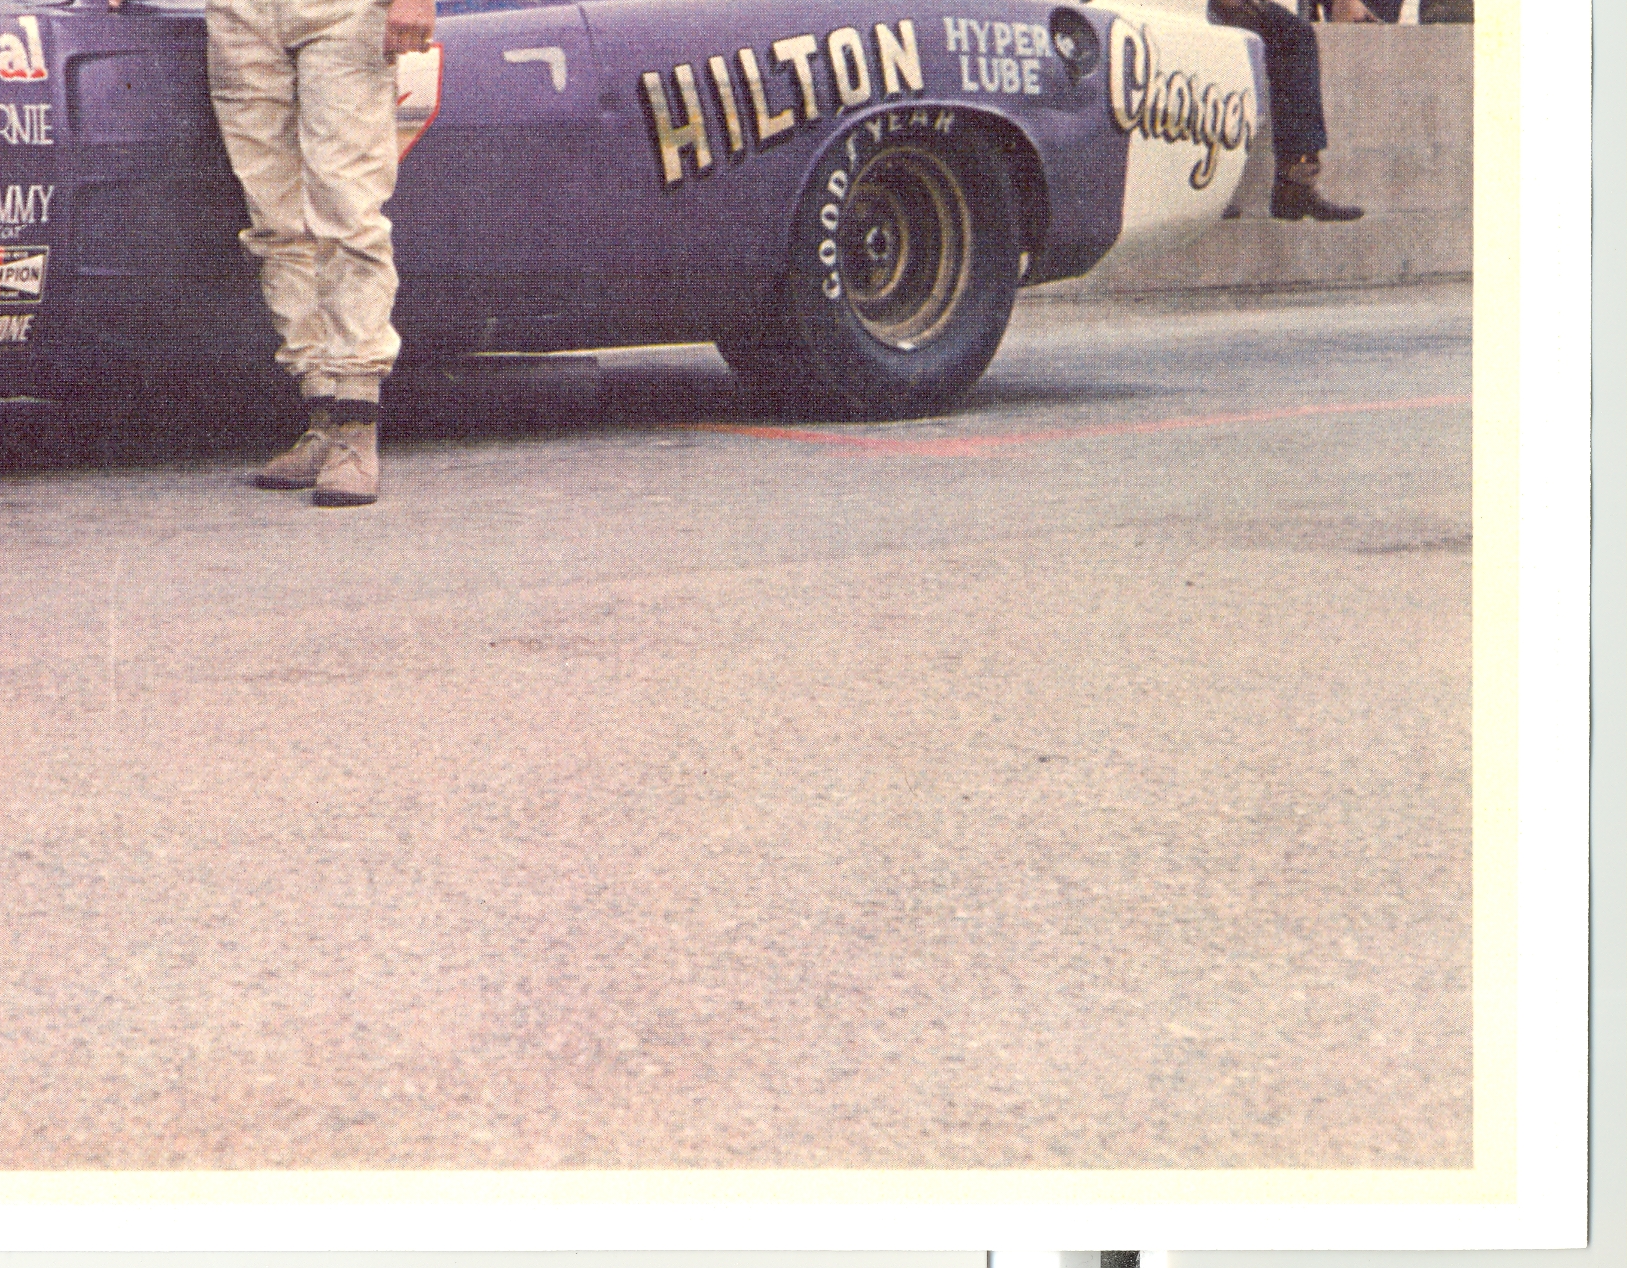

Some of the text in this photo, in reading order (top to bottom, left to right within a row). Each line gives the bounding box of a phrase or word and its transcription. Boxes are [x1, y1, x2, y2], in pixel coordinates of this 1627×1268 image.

[943, 17, 1054, 59] HYPER
[958, 54, 1043, 96] LUBE
[639, 19, 925, 187] HILTON
[1108, 17, 1258, 191] Charger
